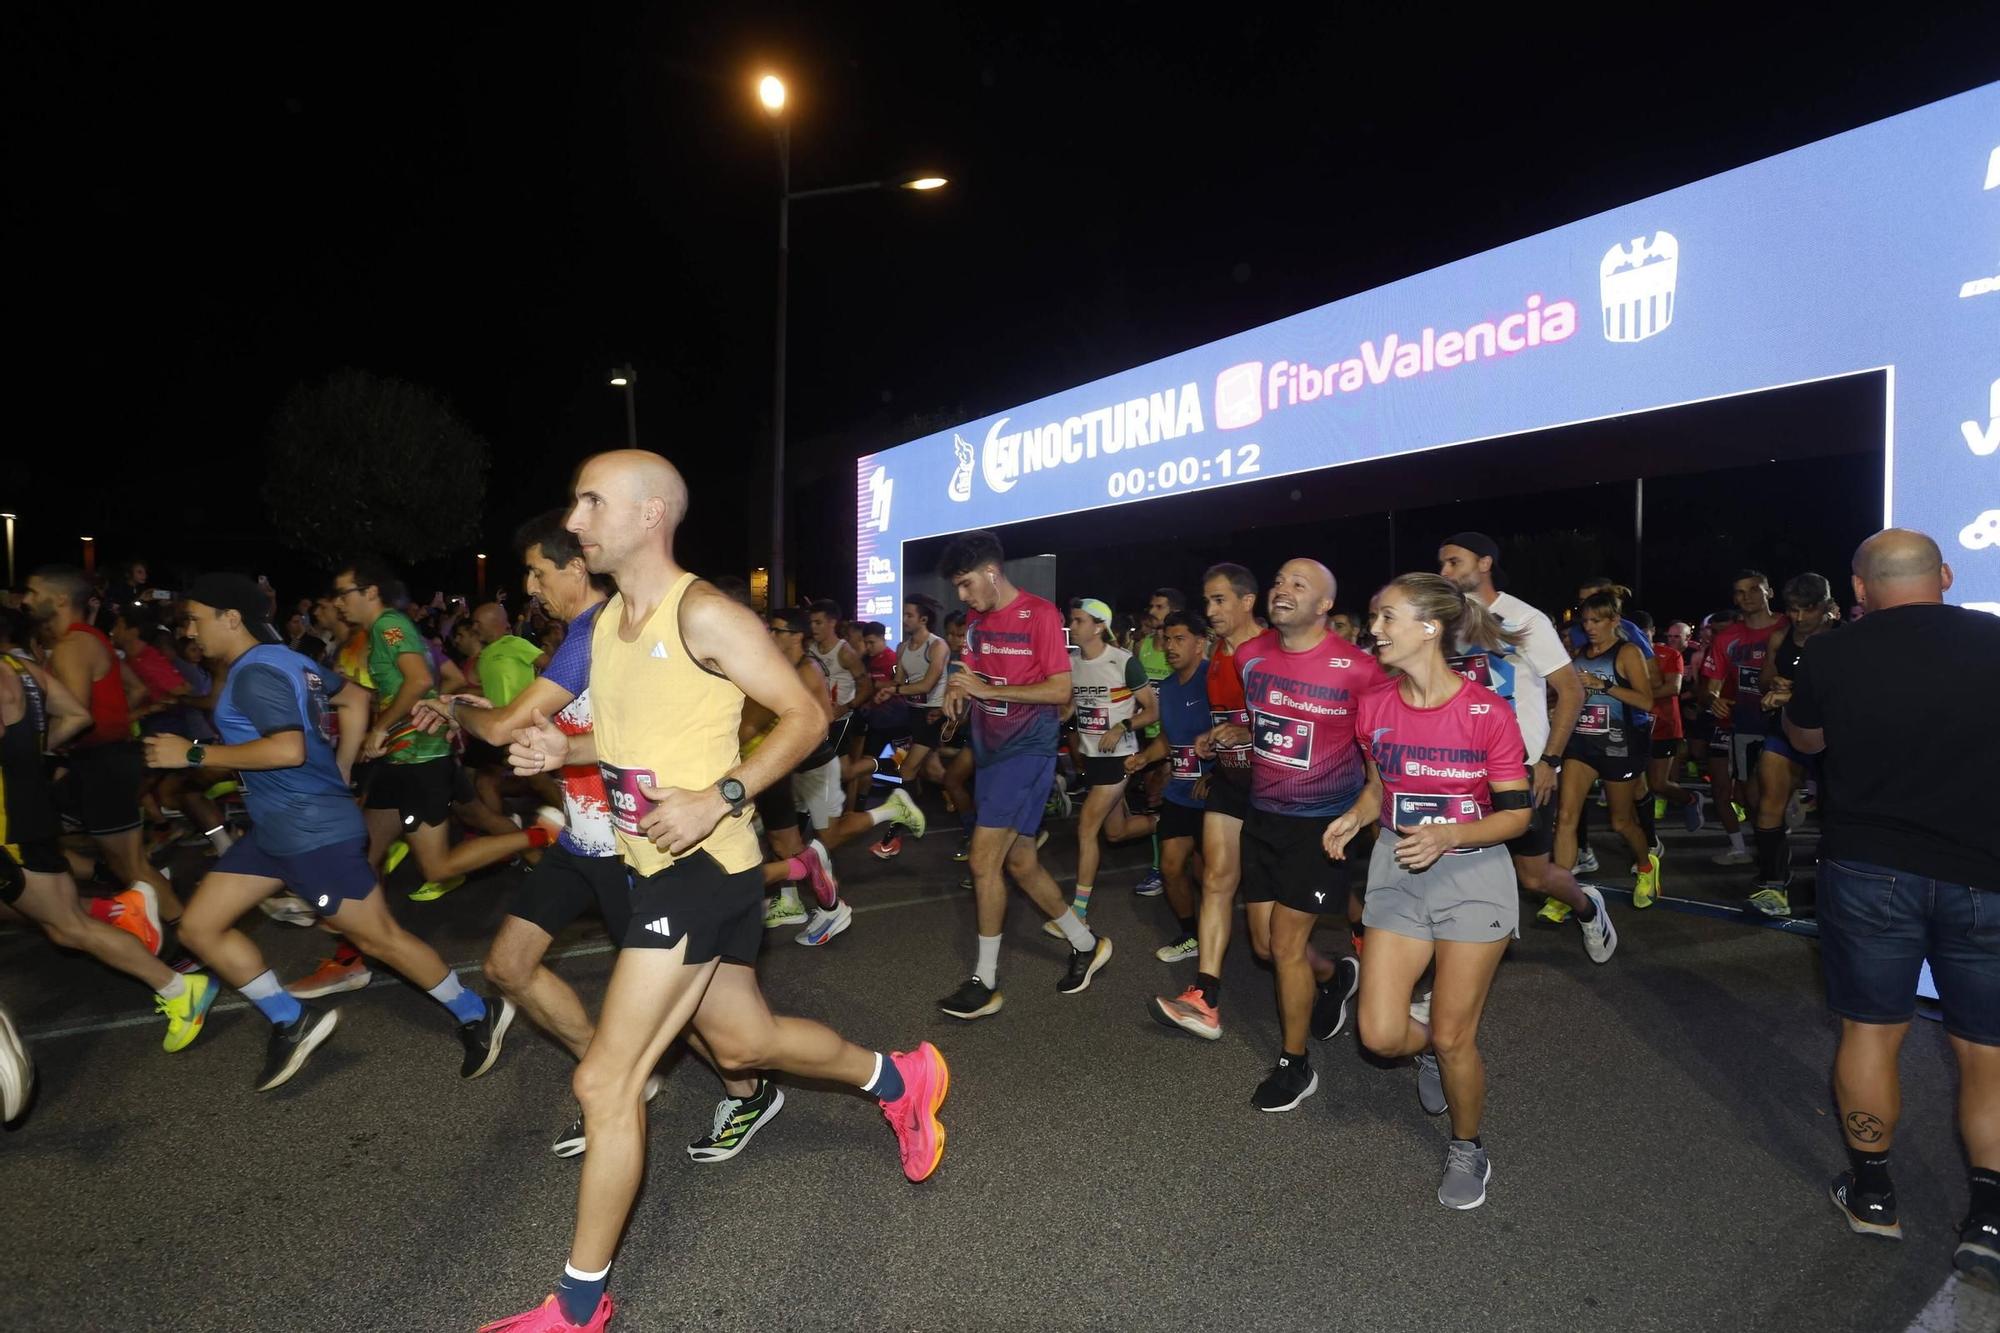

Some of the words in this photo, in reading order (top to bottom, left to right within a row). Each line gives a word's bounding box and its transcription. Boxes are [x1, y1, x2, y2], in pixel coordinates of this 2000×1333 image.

[1023, 382, 1205, 474] NOCTURNA
[1107, 443, 1261, 498] 00:00:12
[1271, 674, 1350, 703] NOCTURNA
[1264, 731, 1294, 749] 493
[611, 789, 637, 812] 128
